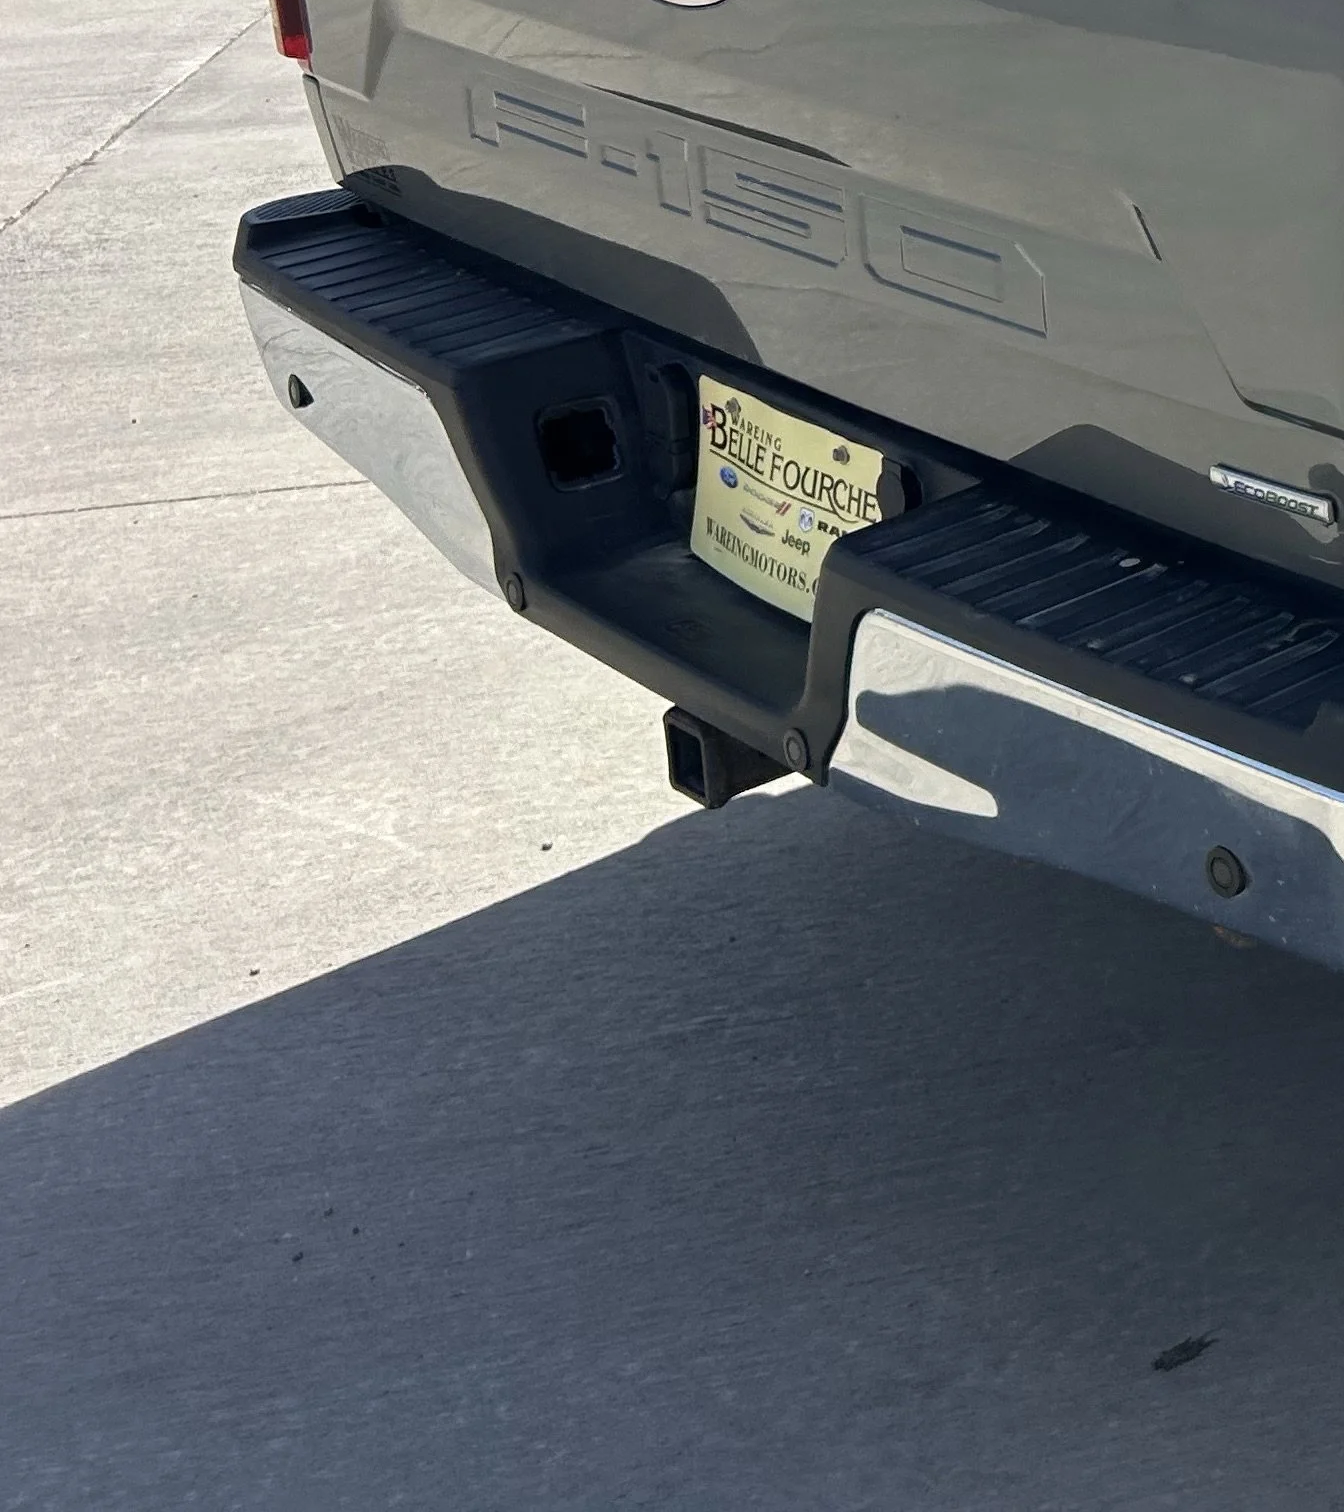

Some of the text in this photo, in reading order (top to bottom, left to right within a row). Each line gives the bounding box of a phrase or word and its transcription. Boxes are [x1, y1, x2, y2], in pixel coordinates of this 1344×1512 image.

[466, 72, 1048, 339] F-150
[731, 413, 782, 452] WAREING
[710, 403, 878, 524] BELLE FOURCHE
[781, 528, 811, 556] Jeep
[817, 520, 851, 538] RA
